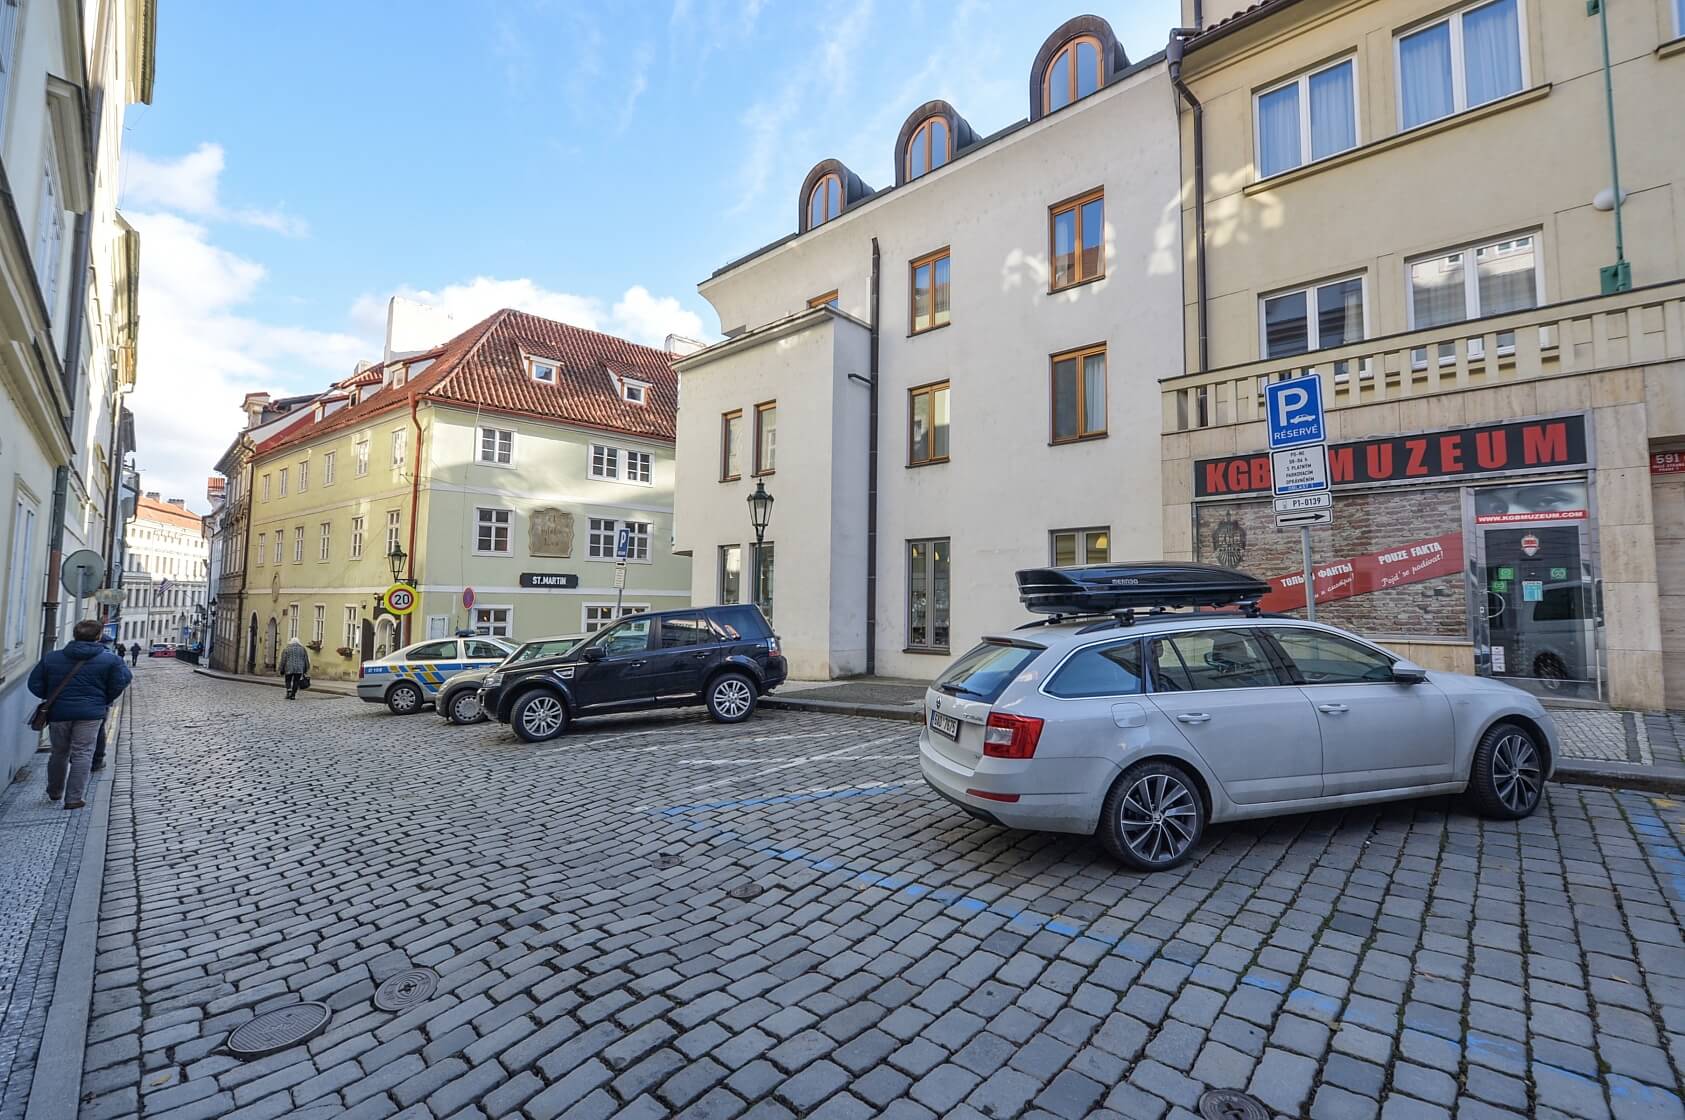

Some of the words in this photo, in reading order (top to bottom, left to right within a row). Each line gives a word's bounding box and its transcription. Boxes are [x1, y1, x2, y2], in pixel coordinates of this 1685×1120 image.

[1278, 388, 1308, 426] P
[1274, 424, 1318, 440] RÉSERVÉ
[1206, 457, 1271, 493] KGB
[1328, 423, 1568, 481] MUZEUM
[1655, 453, 1680, 464] 591
[1293, 497, 1321, 508] P1-0139
[1478, 511, 1583, 522] WWW.KGBMUZEUM.COM
[620, 531, 627, 548] P
[1378, 550, 1409, 565] POUZE
[1411, 542, 1442, 557] FAKTA
[532, 576, 567, 585] ST.MARTIN
[1280, 572, 1315, 588] ТОЛЬ
[394, 594, 410, 606] 20
